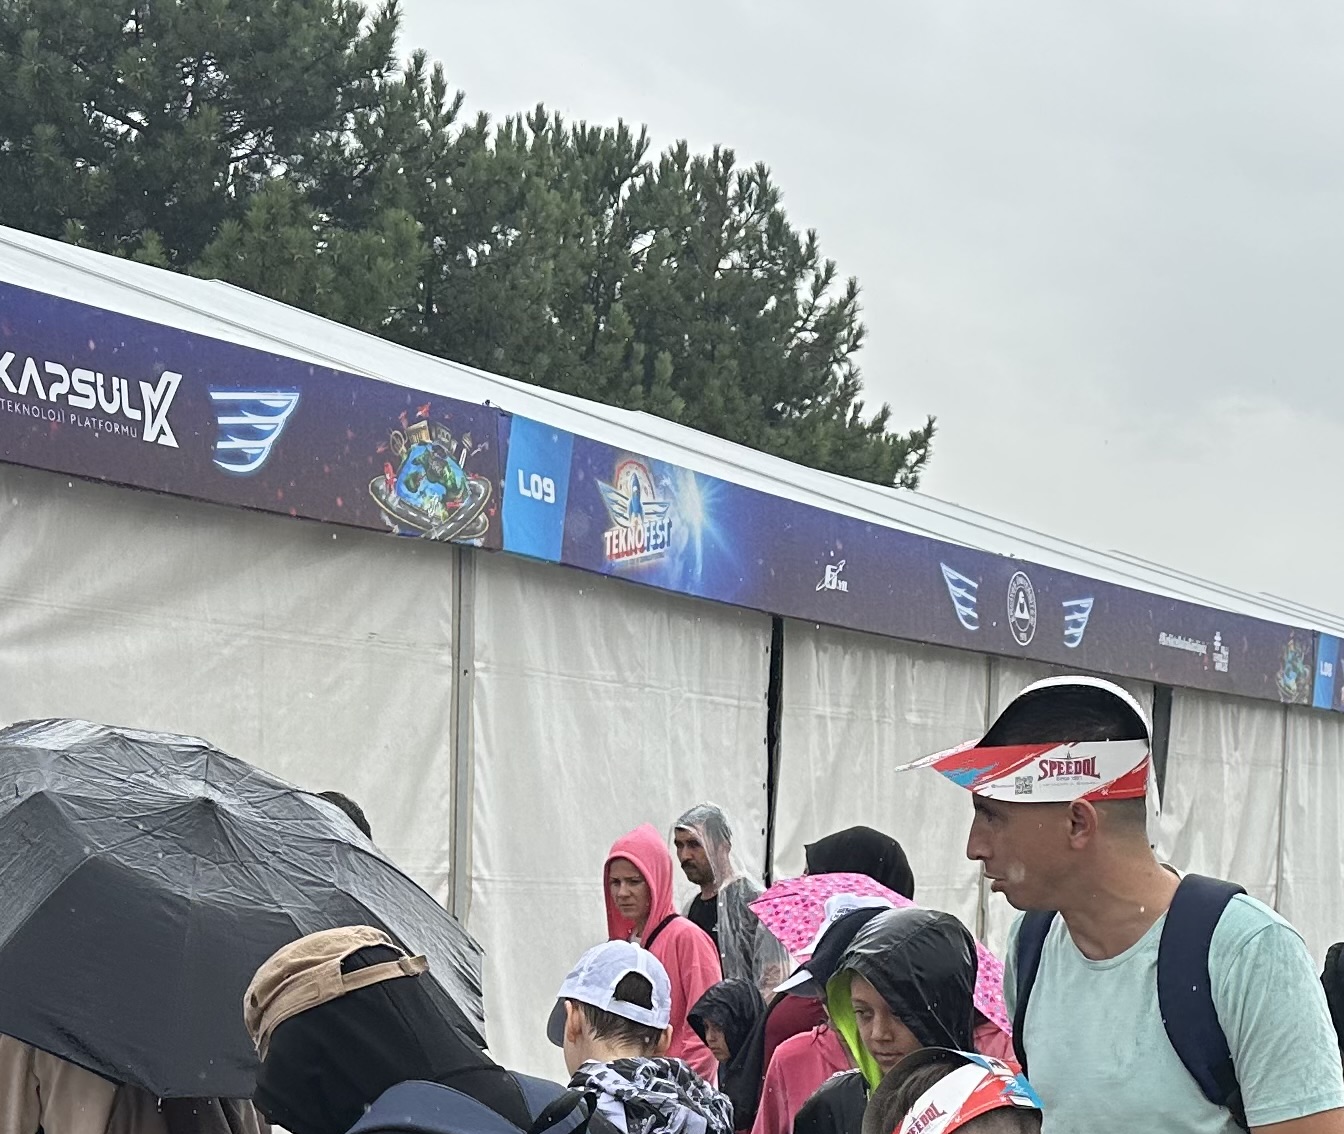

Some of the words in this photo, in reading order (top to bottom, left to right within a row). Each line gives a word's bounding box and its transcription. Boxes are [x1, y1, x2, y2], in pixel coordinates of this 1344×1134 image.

[70, 413, 138, 438] PLATFORMU
[518, 469, 556, 504] L09
[605, 519, 673, 561] TEKNOFEST
[1037, 756, 1101, 782] SPEEDOL
